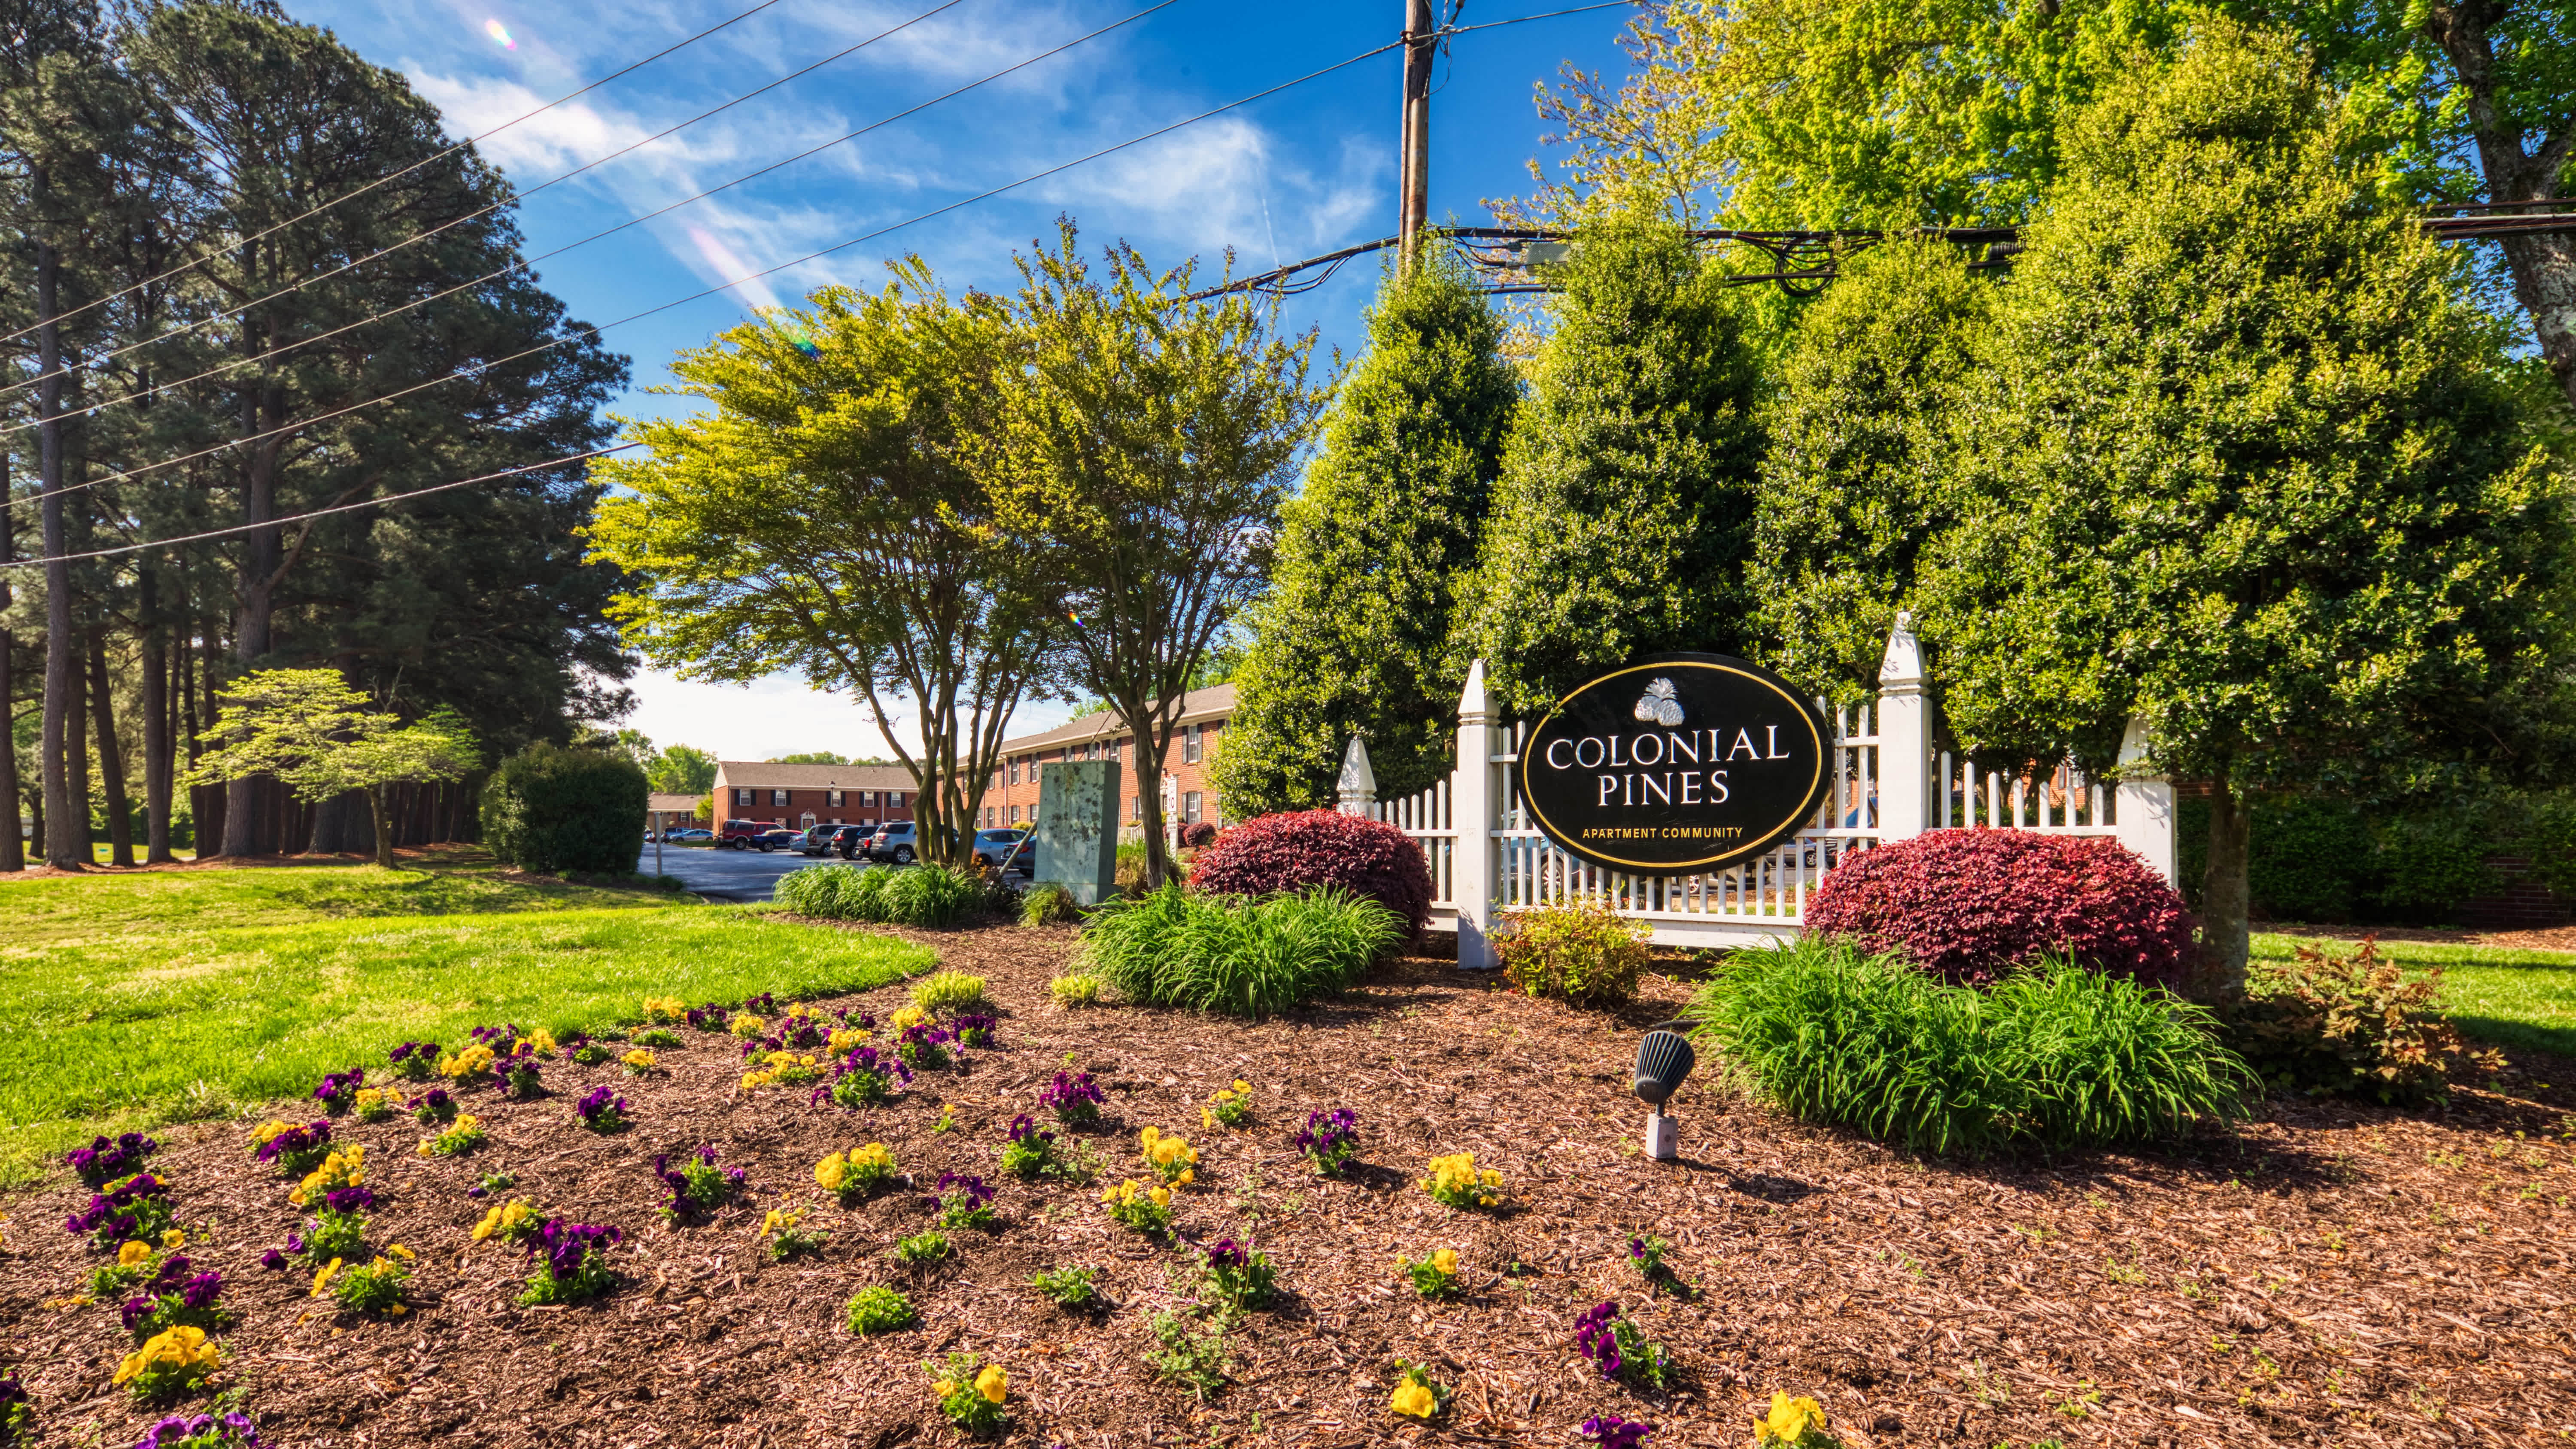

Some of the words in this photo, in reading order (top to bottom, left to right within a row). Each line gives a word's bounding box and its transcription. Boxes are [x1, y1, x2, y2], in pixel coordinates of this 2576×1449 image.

[1547, 726, 1790, 769] COLONIAL
[1598, 770, 1729, 806] PINES
[1169, 797, 1175, 809] 10
[1583, 827, 1656, 838] APARTMENT
[1662, 827, 1743, 838] COMMUNITY
